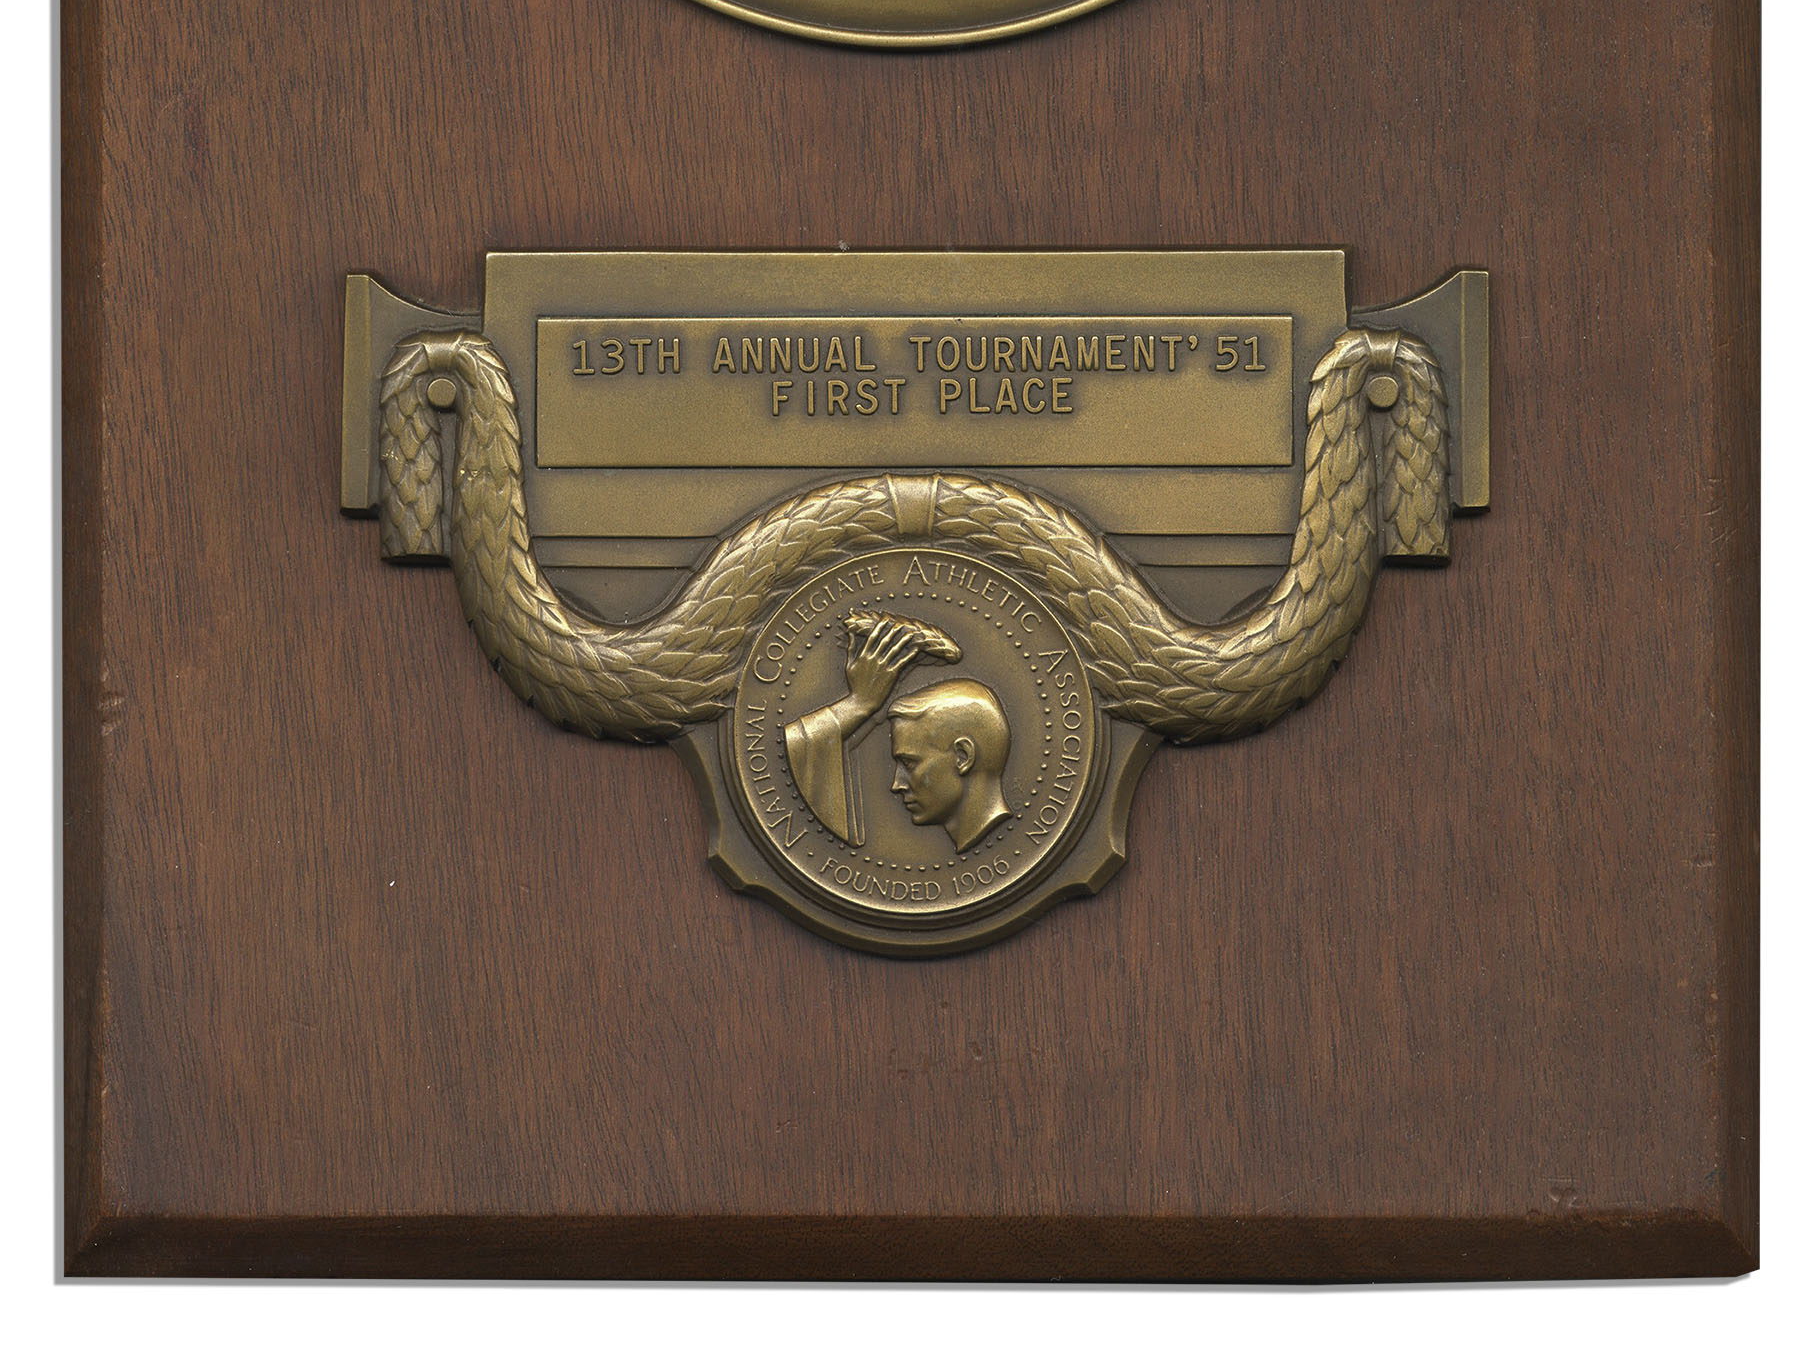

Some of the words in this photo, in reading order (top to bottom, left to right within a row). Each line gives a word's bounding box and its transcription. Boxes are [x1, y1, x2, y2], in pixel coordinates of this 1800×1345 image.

[572, 337, 681, 375] 13TH
[712, 336, 877, 373] ANNUAL
[772, 378, 906, 416] FIRST
[939, 377, 1073, 414] PLACE
[819, 857, 941, 901] FOUNDED
[952, 857, 1010, 895] 1906
